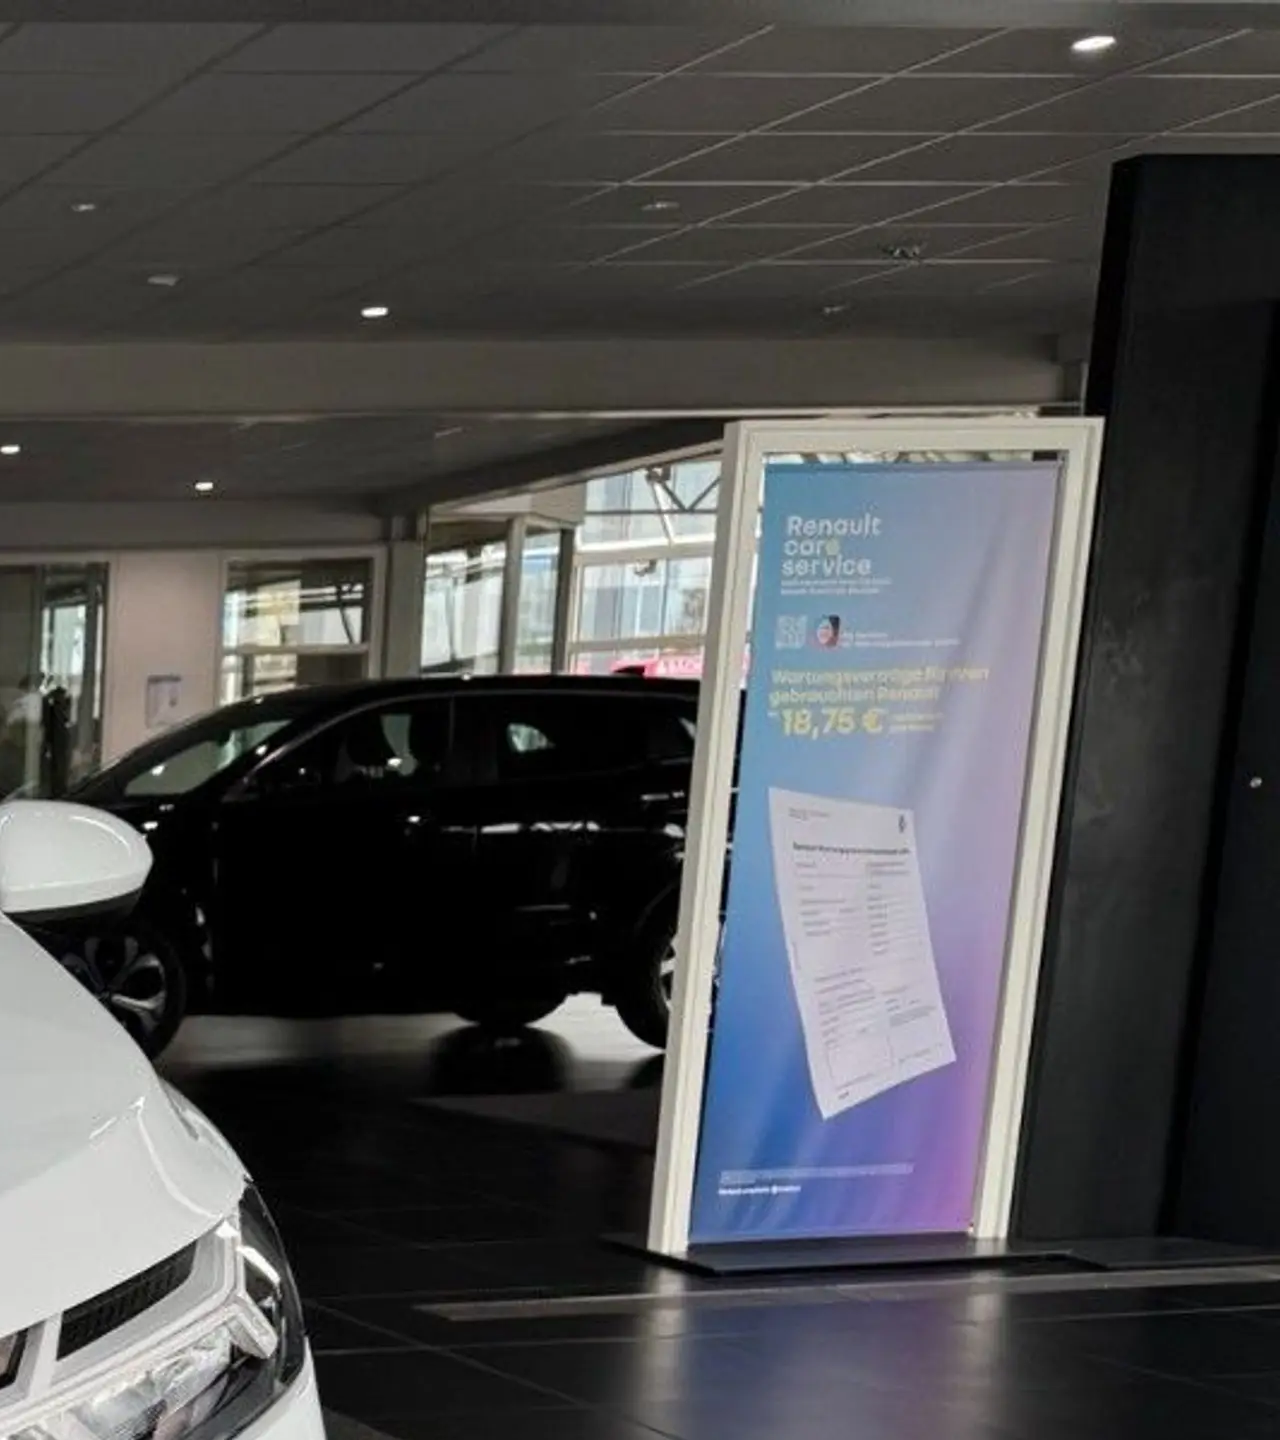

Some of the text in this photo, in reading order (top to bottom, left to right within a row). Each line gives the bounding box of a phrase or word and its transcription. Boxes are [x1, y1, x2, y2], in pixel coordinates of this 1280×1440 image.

[787, 514, 881, 537] Renault
[784, 540, 839, 555] care
[781, 556, 872, 576] service
[781, 708, 856, 738] 18,75
